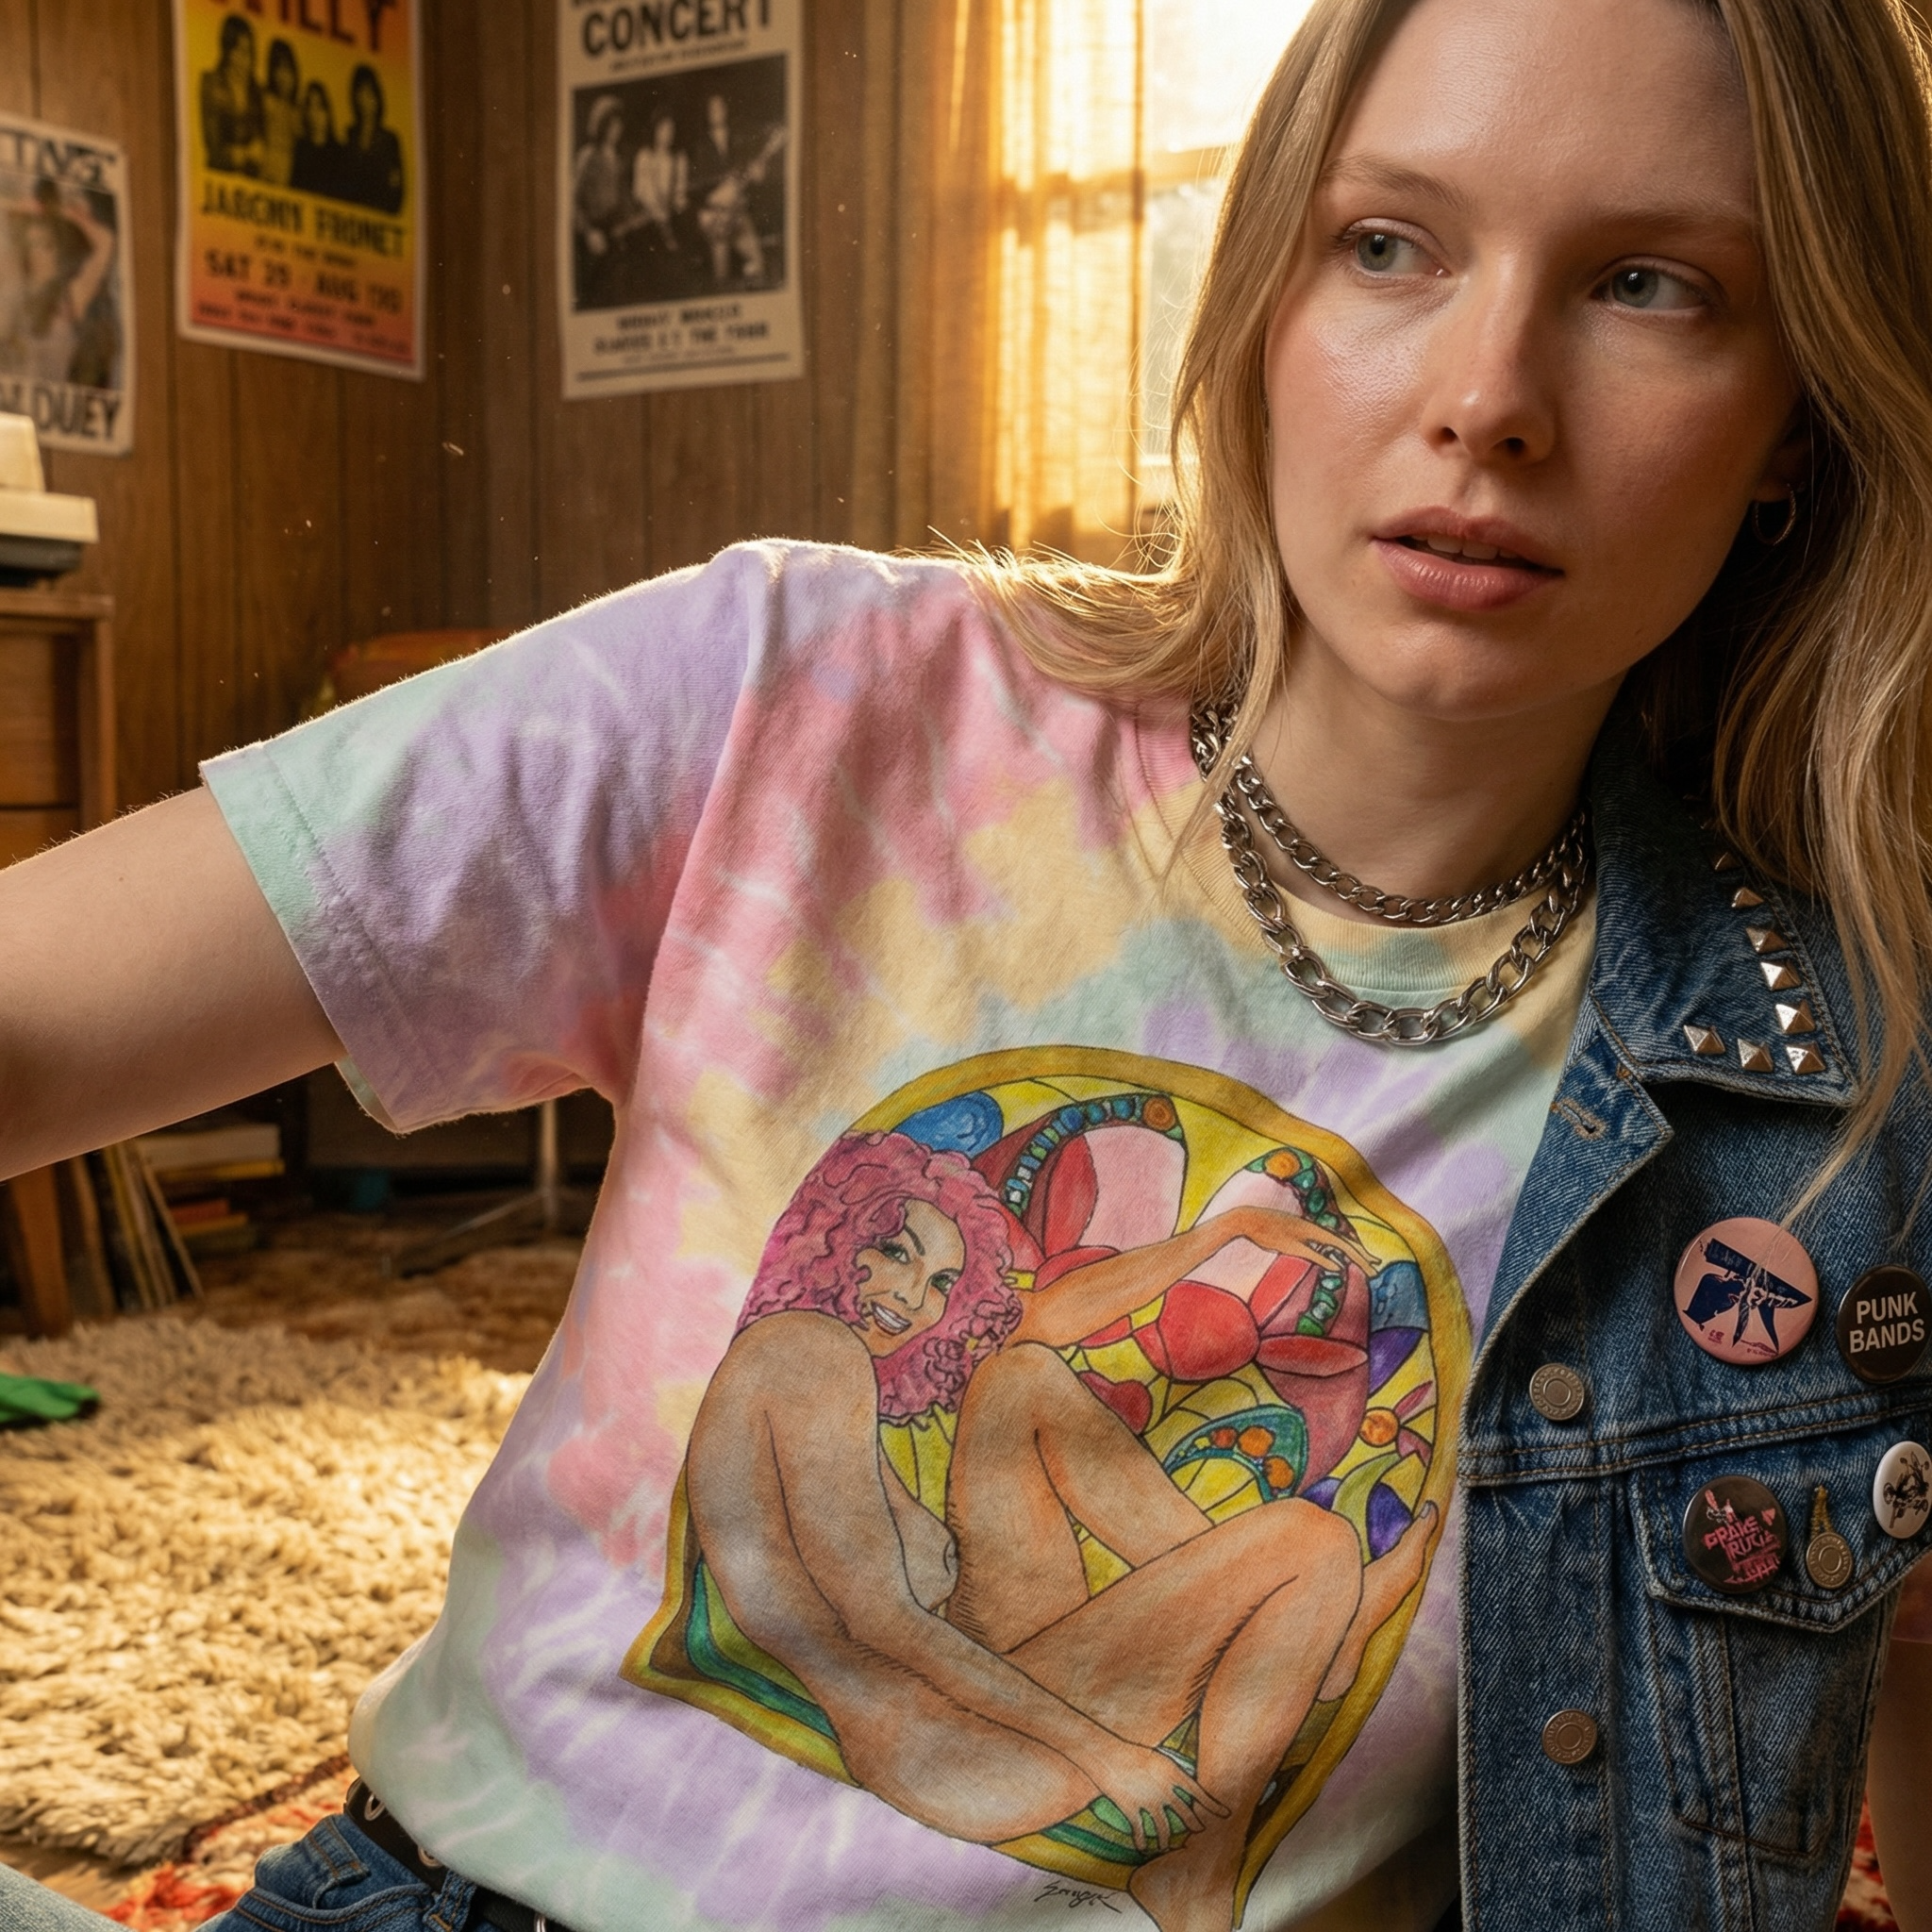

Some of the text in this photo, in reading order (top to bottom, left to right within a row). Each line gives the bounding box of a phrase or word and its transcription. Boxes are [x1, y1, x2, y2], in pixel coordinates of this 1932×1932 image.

[582, 0, 770, 58] CONCERT
[1856, 1291, 1919, 1324] PUNK
[1849, 1318, 1925, 1354] BANDS
